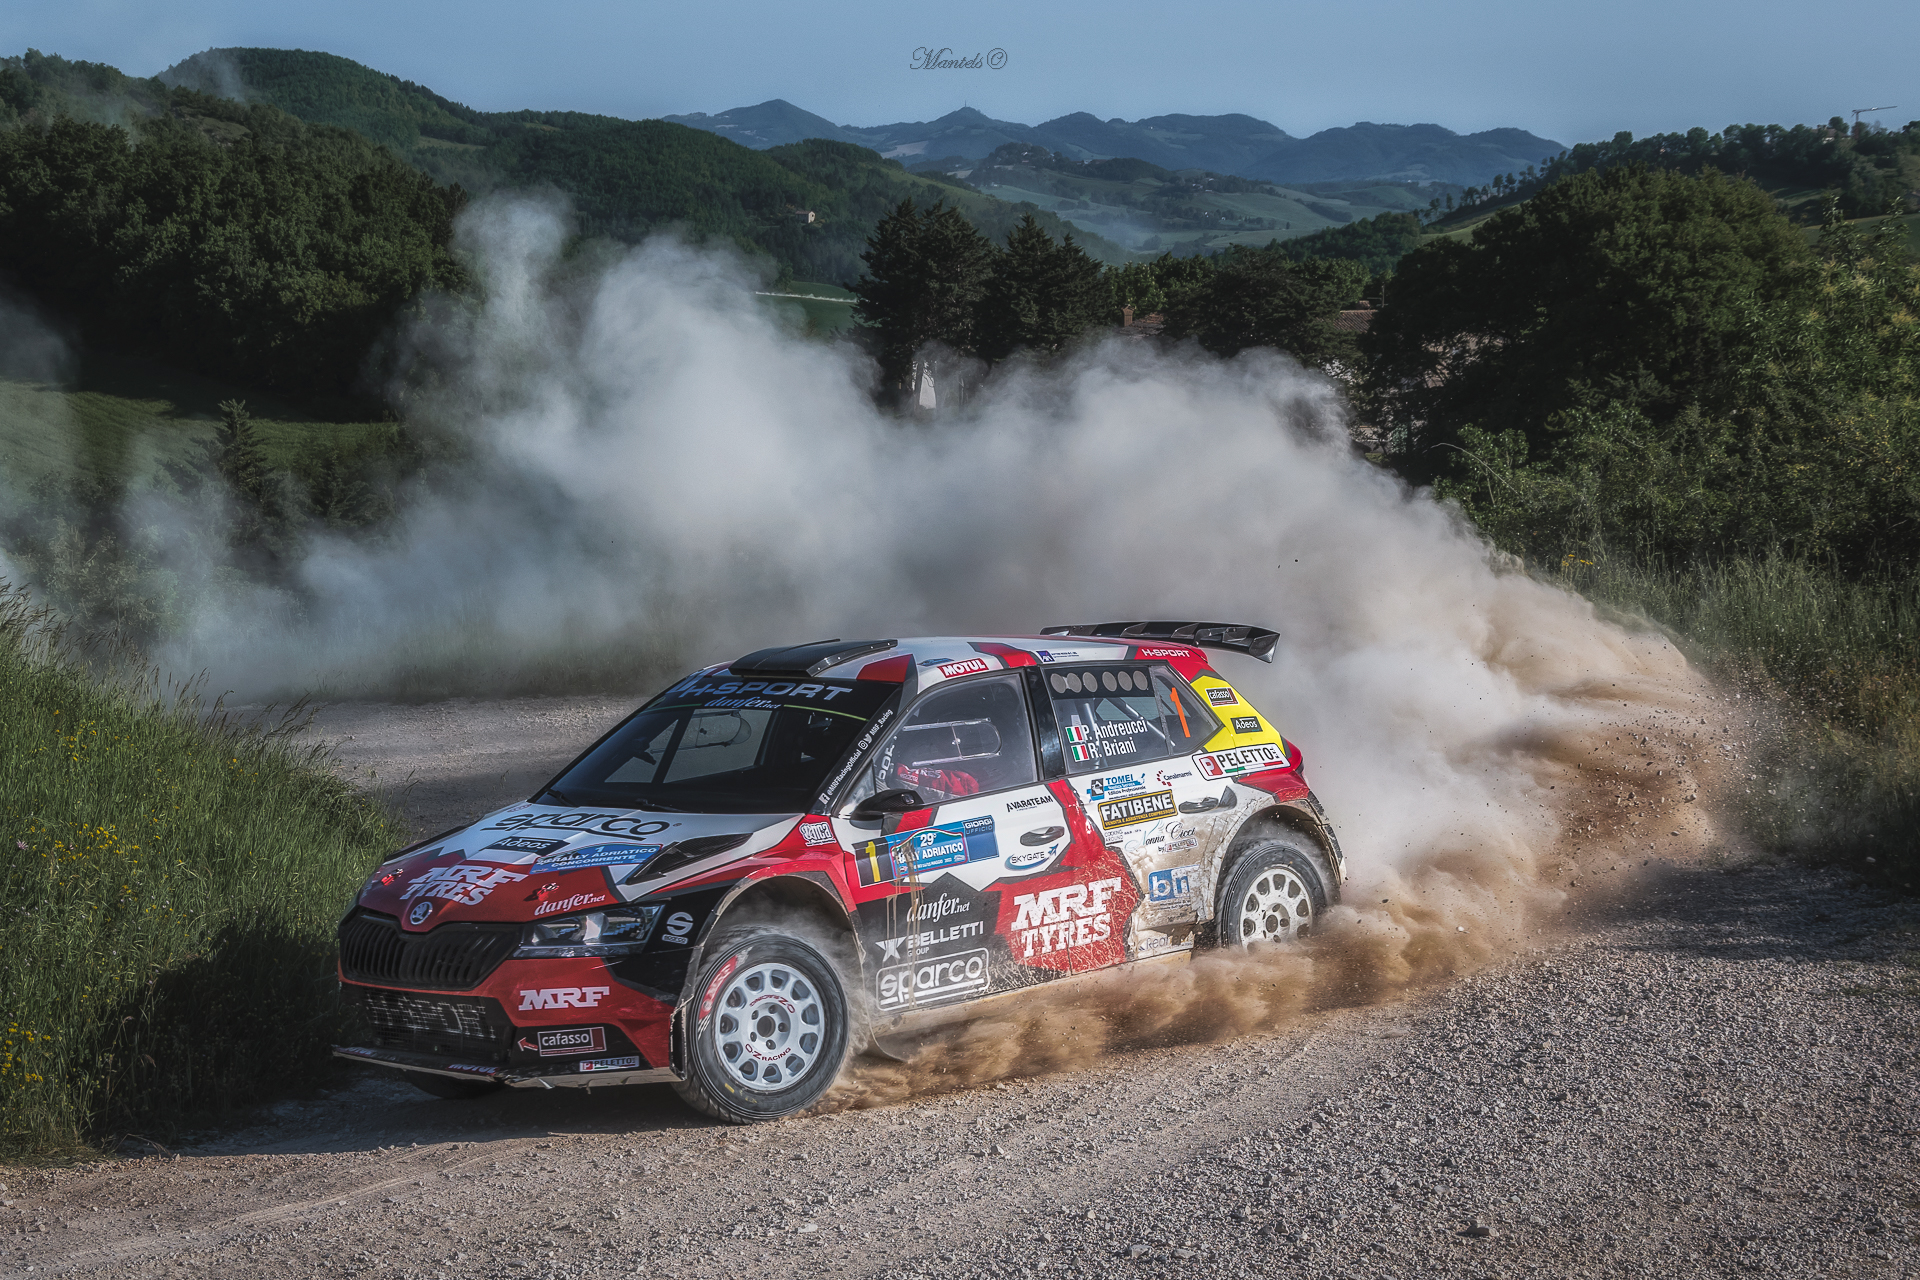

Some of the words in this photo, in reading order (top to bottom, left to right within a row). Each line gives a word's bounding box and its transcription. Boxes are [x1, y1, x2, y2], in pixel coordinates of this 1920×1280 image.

[1141, 648, 1190, 658] H-SPORT
[942, 659, 985, 677] MOTUL
[1169, 687, 1191, 738] 1
[1083, 723, 1094, 741] P.
[1095, 718, 1148, 739] Andreucci
[1235, 717, 1257, 730] Adeos
[1089, 741, 1102, 759] R.
[1103, 737, 1137, 758] Briani
[1216, 747, 1274, 768] PELETTO
[827, 749, 862, 795] @MRFRacingOfficial
[1105, 773, 1134, 785] TOMEI
[1101, 793, 1174, 820] FATIBENE
[480, 812, 671, 841] sparco
[964, 818, 993, 829] GIORGI
[966, 825, 993, 835] UFFICIO
[498, 838, 551, 849] Adeos
[592, 847, 657, 858] ADRIATICO
[923, 842, 964, 859] ADRIATICO
[551, 855, 636, 868] CONCORRENTE
[865, 841, 881, 883] 1
[1011, 851, 1045, 864] SKYGATE
[408, 865, 529, 890] MRF
[400, 881, 494, 906] TYRES
[1011, 877, 1122, 931] MRF
[534, 893, 606, 917] danfer.net
[907, 921, 984, 949] BELLETTI
[1022, 913, 1111, 958] TYRES
[880, 956, 985, 1005] sparco
[518, 986, 610, 1011] MRF
[541, 1032, 590, 1047] cafasso
[594, 1057, 632, 1067] PELETTO
[762, 1047, 791, 1062] RACING
[449, 1063, 498, 1074] MOTUL
